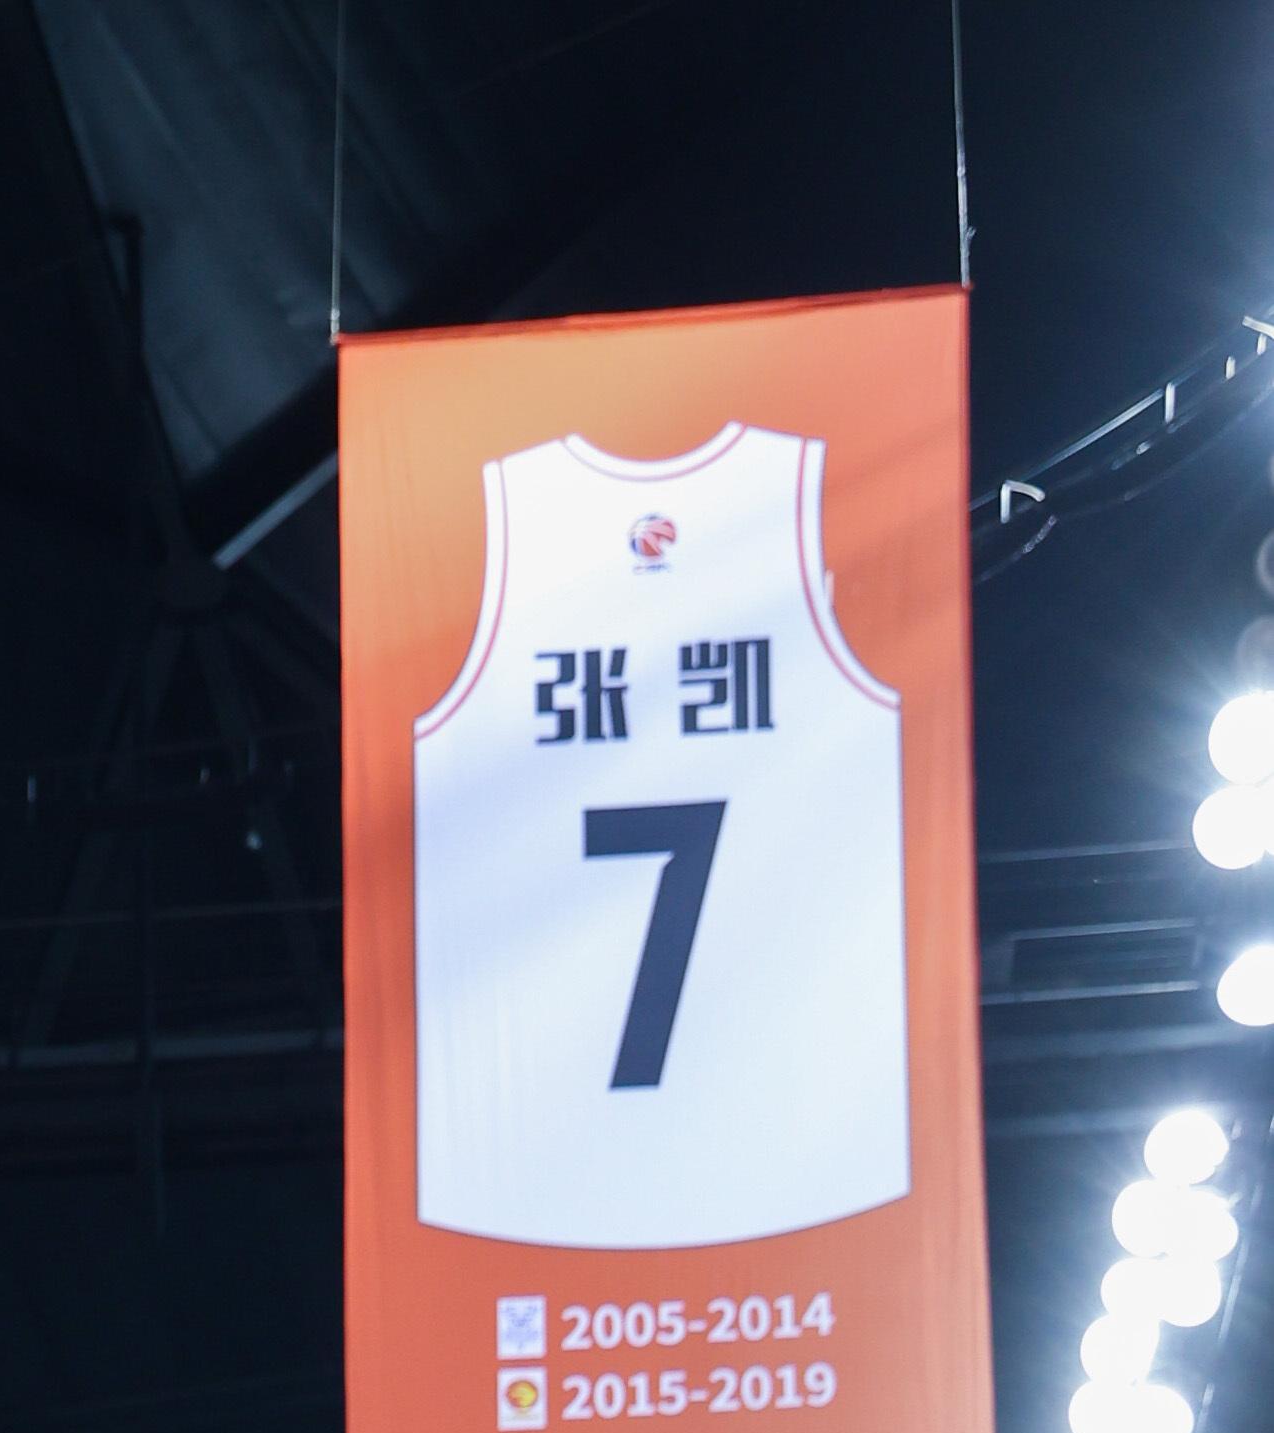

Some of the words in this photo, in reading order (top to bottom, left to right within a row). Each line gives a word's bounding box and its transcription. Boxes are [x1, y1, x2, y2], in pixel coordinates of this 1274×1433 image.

[536, 638, 773, 745] 张凯
[583, 798, 729, 1092] 7
[560, 1291, 837, 1351] 2005-2014
[560, 1361, 838, 1421] 2015-2019
